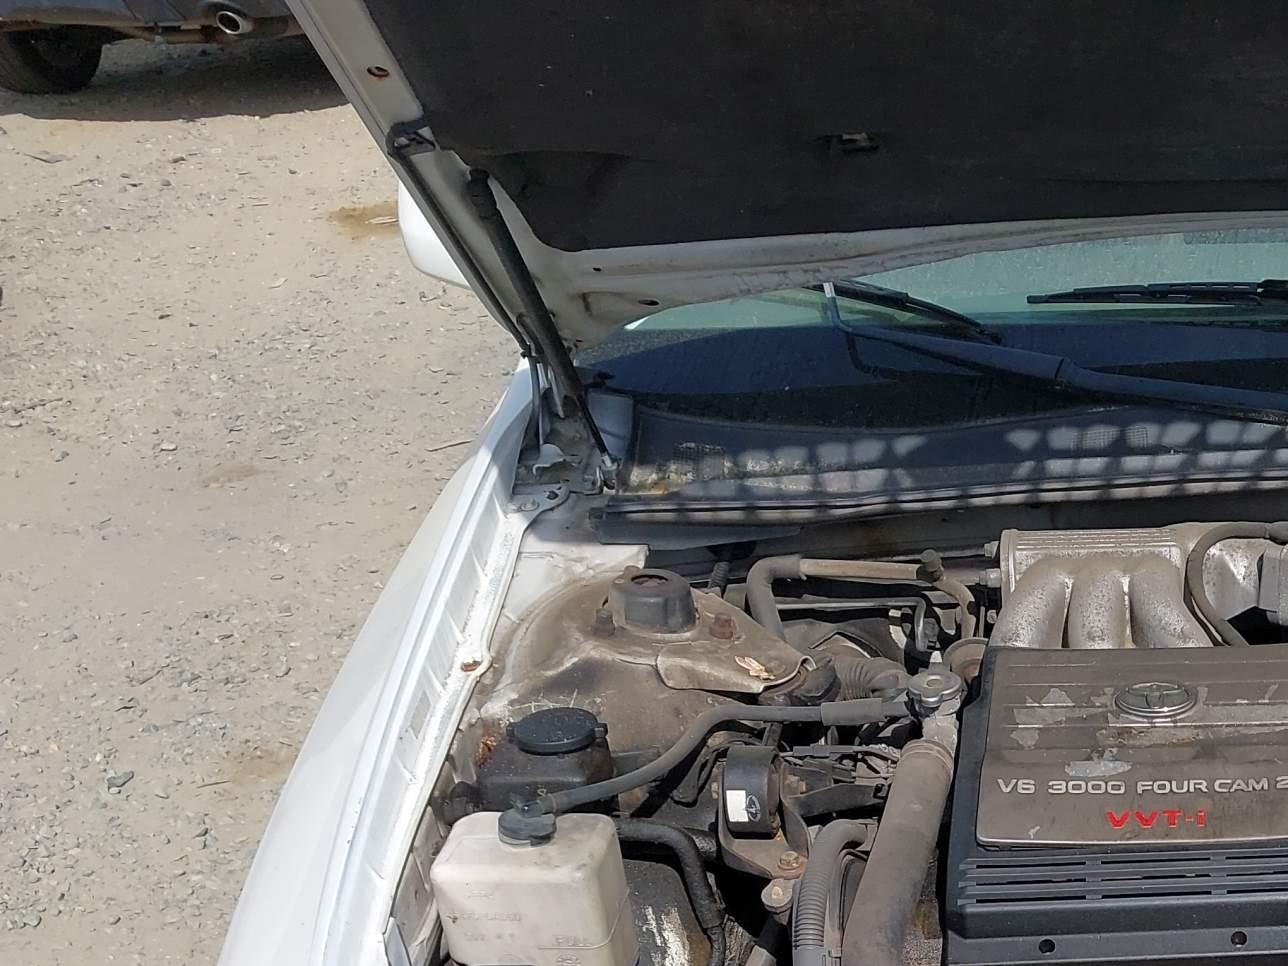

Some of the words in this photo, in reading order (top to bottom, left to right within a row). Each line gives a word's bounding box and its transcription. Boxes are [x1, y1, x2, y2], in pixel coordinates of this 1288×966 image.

[998, 777, 1036, 795] V6
[1048, 780, 1125, 796] 3000
[1136, 779, 1209, 795] FOUR
[1214, 776, 1269, 794] CAM
[1105, 808, 1207, 830] VVT-i
